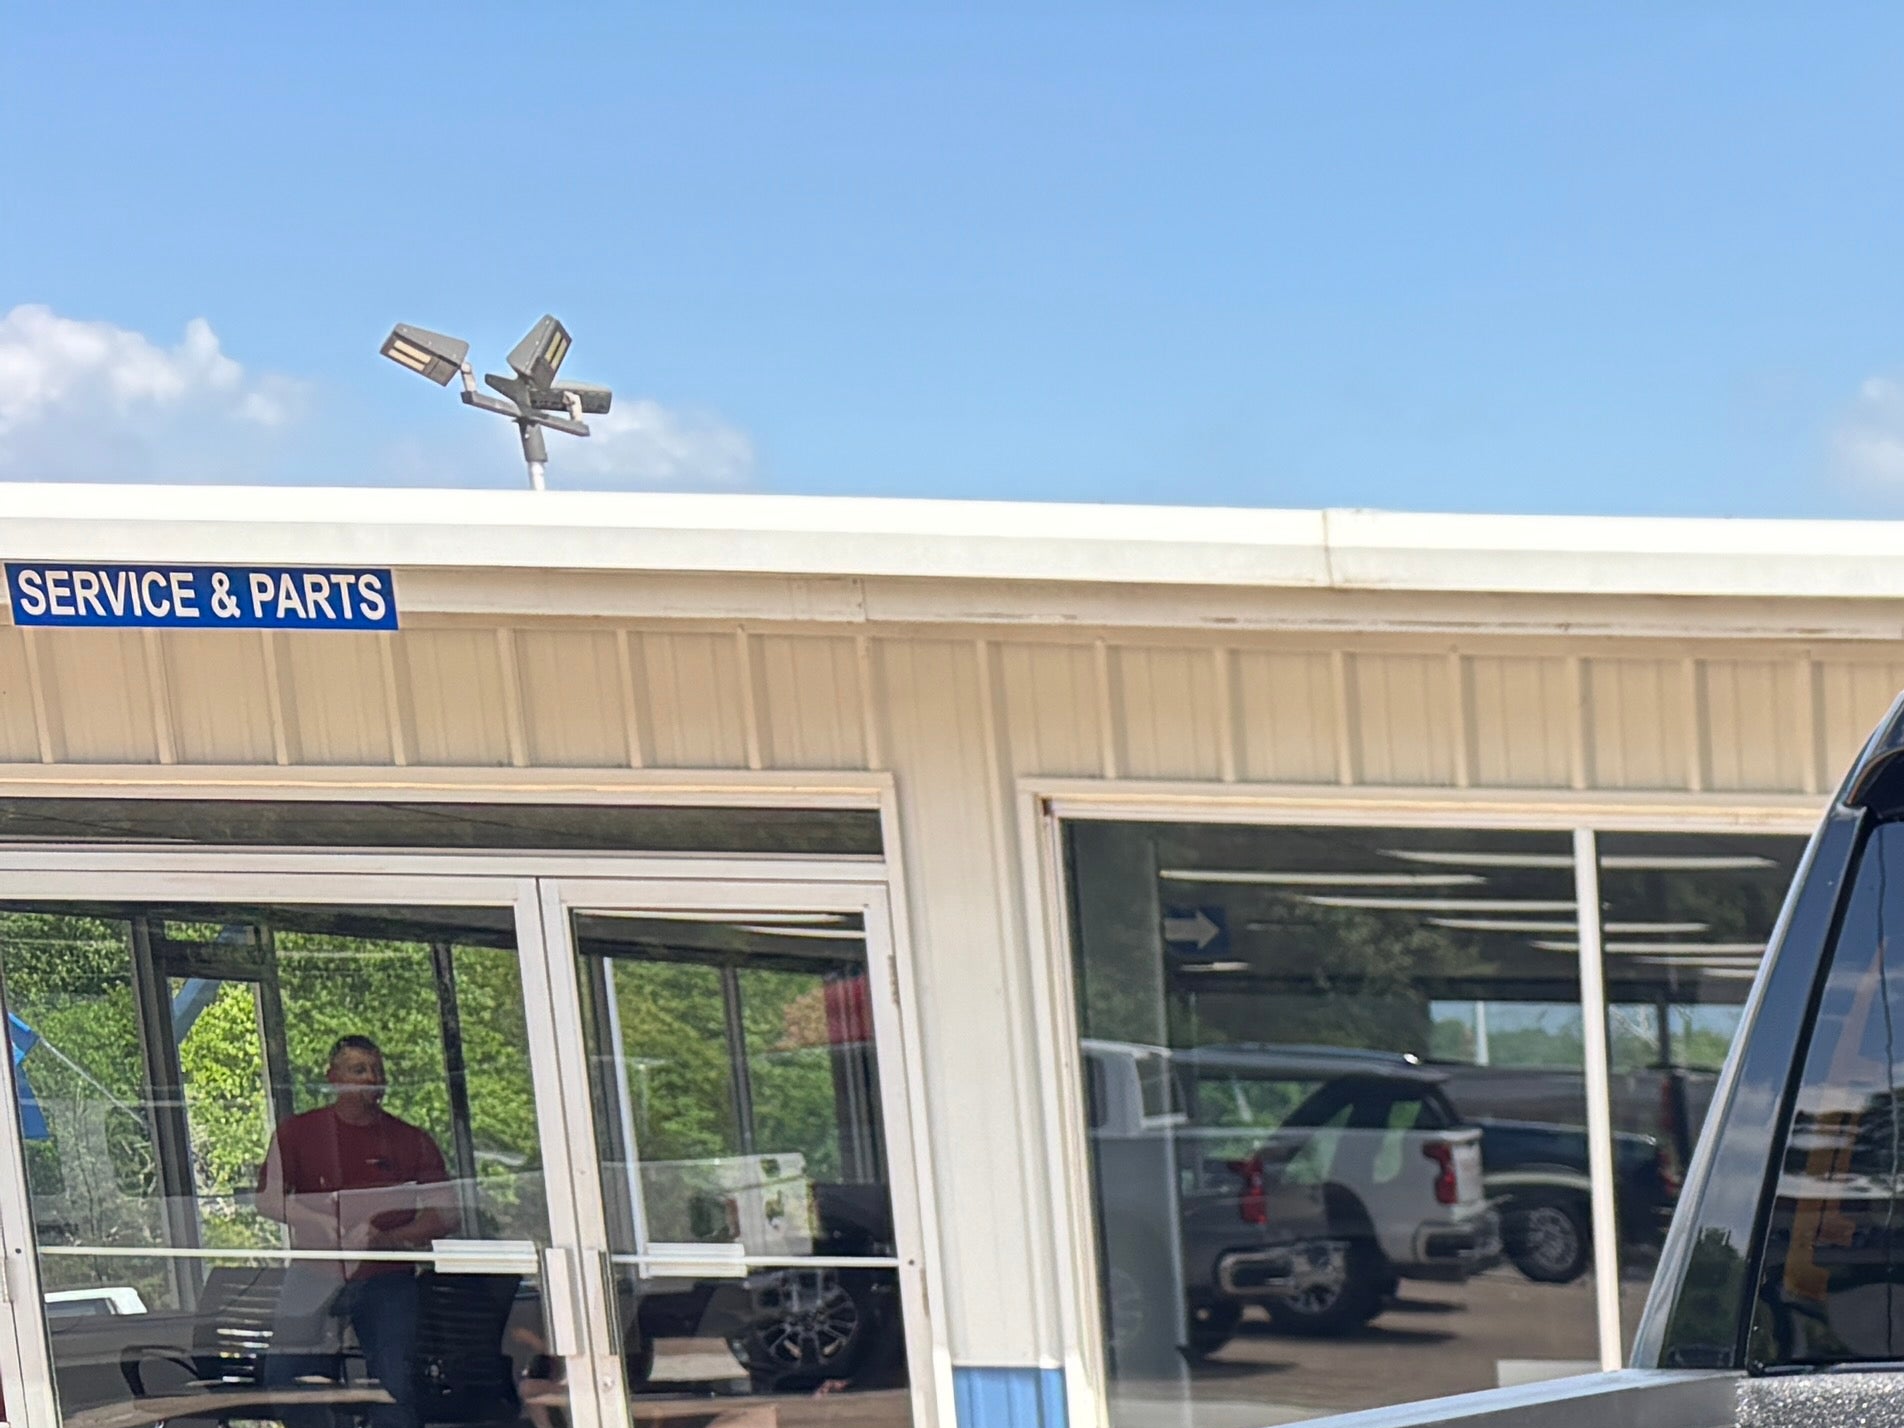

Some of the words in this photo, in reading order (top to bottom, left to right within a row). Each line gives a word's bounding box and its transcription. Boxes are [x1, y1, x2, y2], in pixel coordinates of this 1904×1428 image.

[18, 569, 200, 618] SERVICE
[211, 571, 241, 618] &
[248, 573, 387, 620] PARTS
